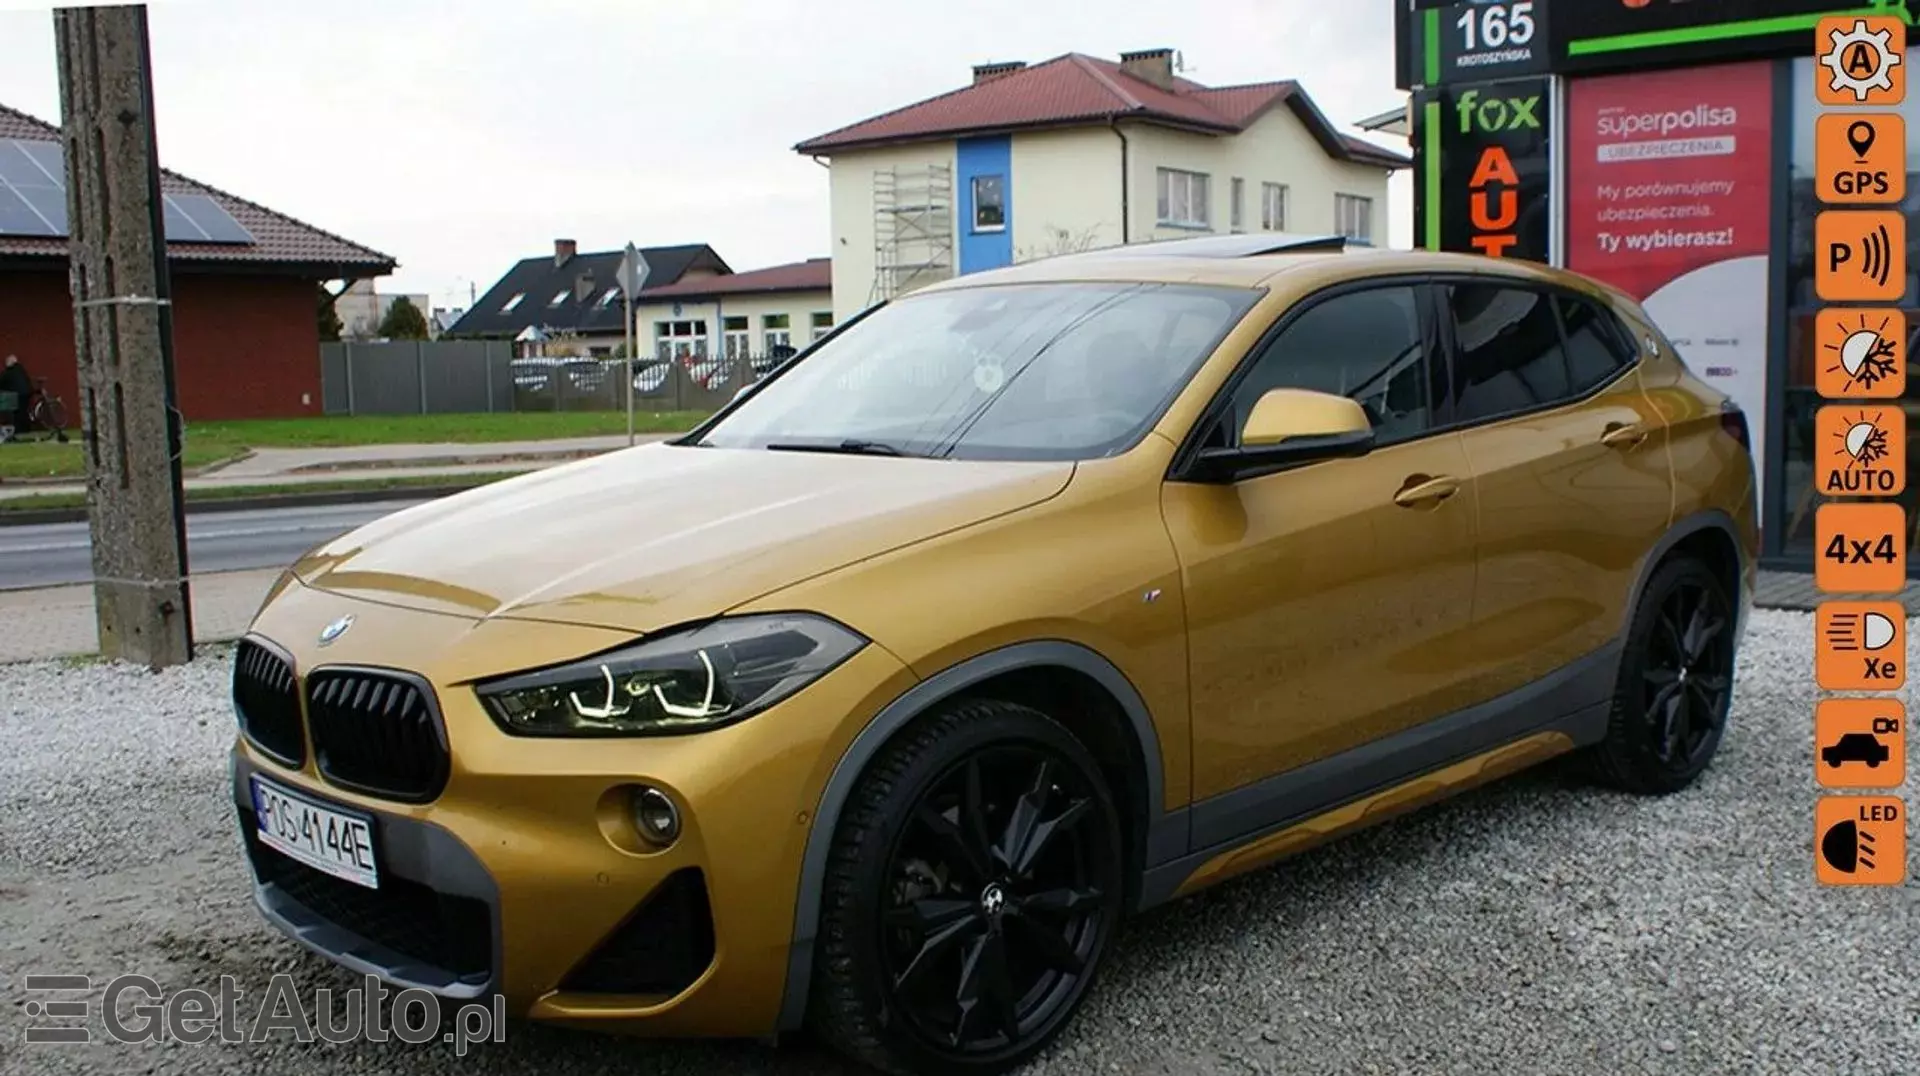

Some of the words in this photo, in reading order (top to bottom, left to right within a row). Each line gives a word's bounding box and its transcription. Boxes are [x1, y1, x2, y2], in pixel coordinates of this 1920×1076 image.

[1456, 2, 1535, 50] 165
[1456, 49, 1532, 68] KROTOSZYŃSKA
[1456, 89, 1541, 134] fox
[1597, 103, 1738, 139] superpolisa
[1606, 140, 1725, 158] UBEZPIECZENIA
[1597, 185, 1621, 201] My
[1624, 180, 1736, 200] porównujemy
[1597, 203, 1716, 222] ubezpieczenia.
[1597, 232, 1621, 253] Ty
[1626, 227, 1735, 252] wybierasz!
